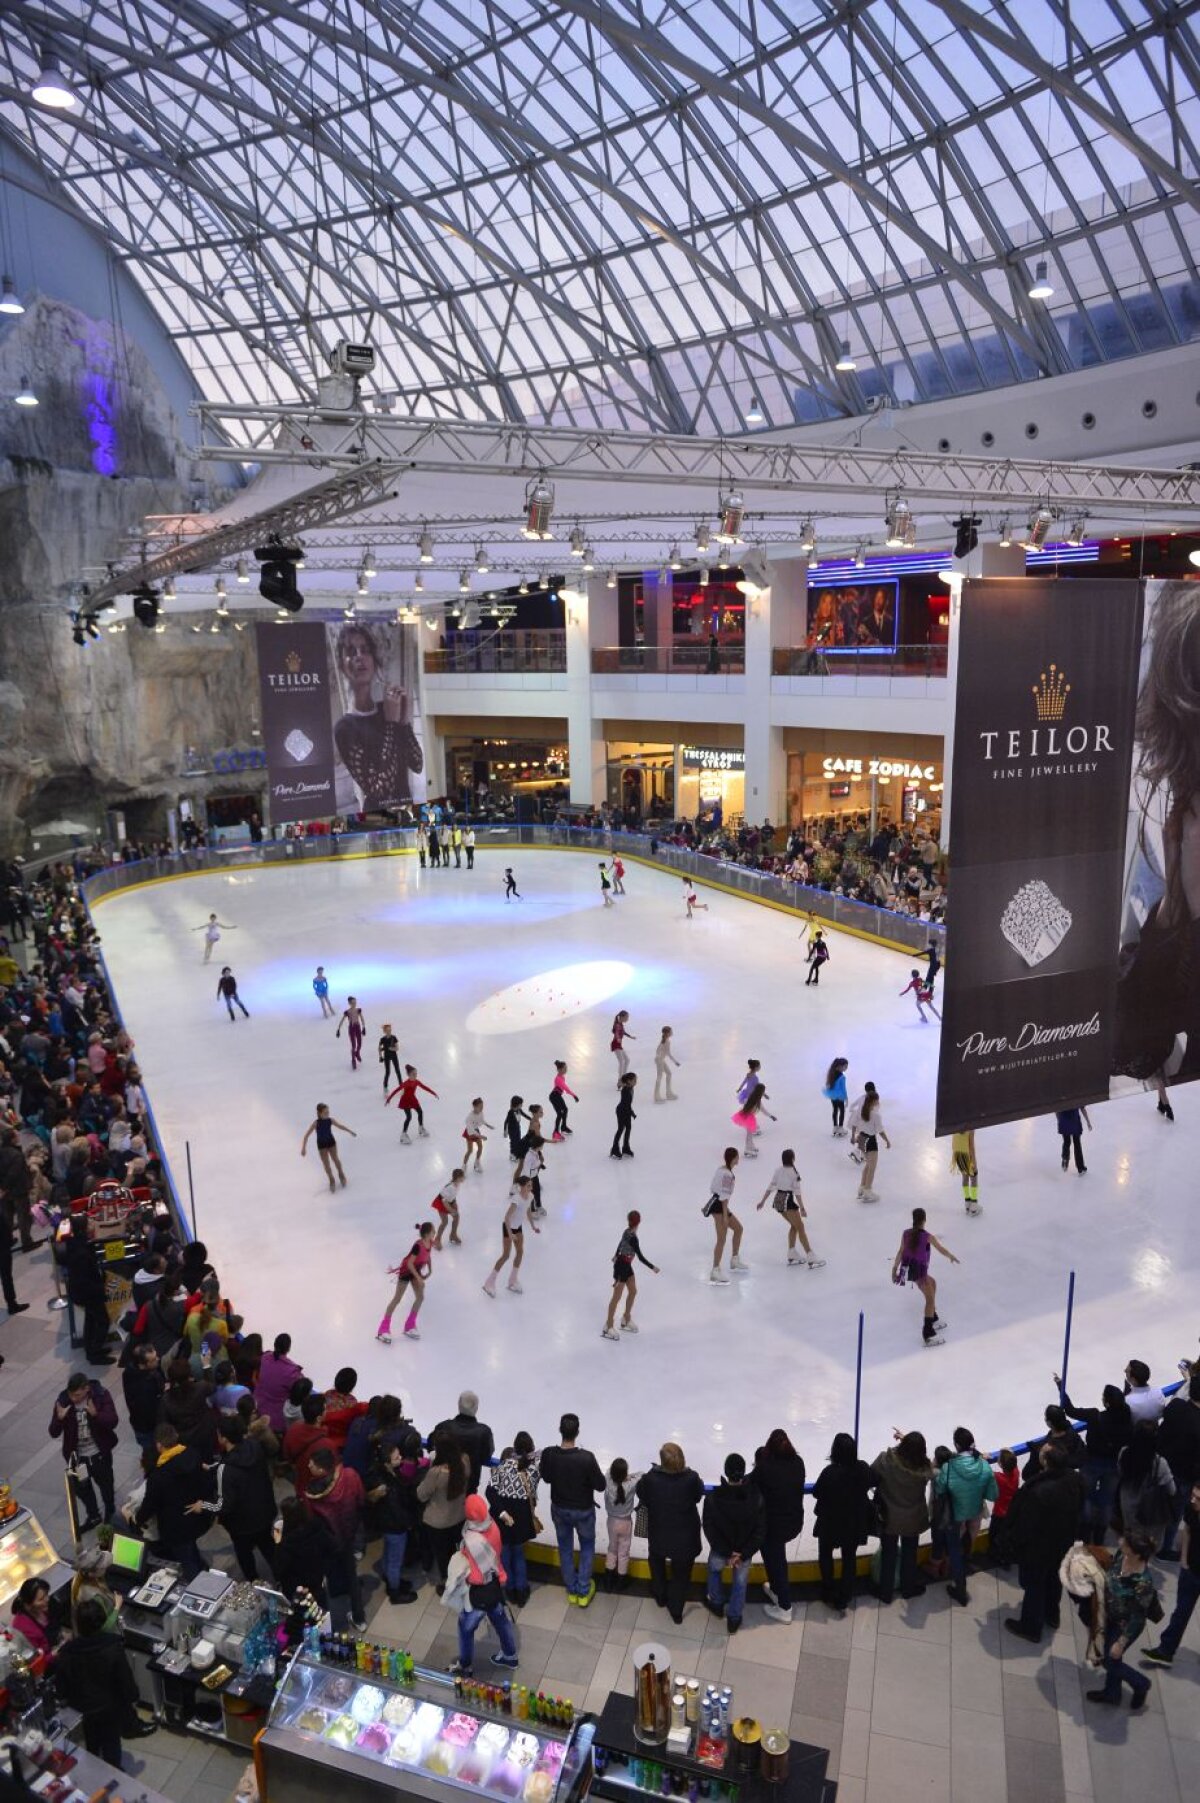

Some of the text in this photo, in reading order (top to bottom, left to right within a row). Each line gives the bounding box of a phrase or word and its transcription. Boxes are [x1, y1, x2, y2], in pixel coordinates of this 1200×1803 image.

[267, 673, 321, 686] TEILOR
[979, 724, 1115, 760] TEILOR
[822, 757, 935, 781] CAFE ZODIAC
[992, 762, 1099, 780] FINE JEWELLERY
[956, 1011, 1102, 1063] Pure Diamonds
